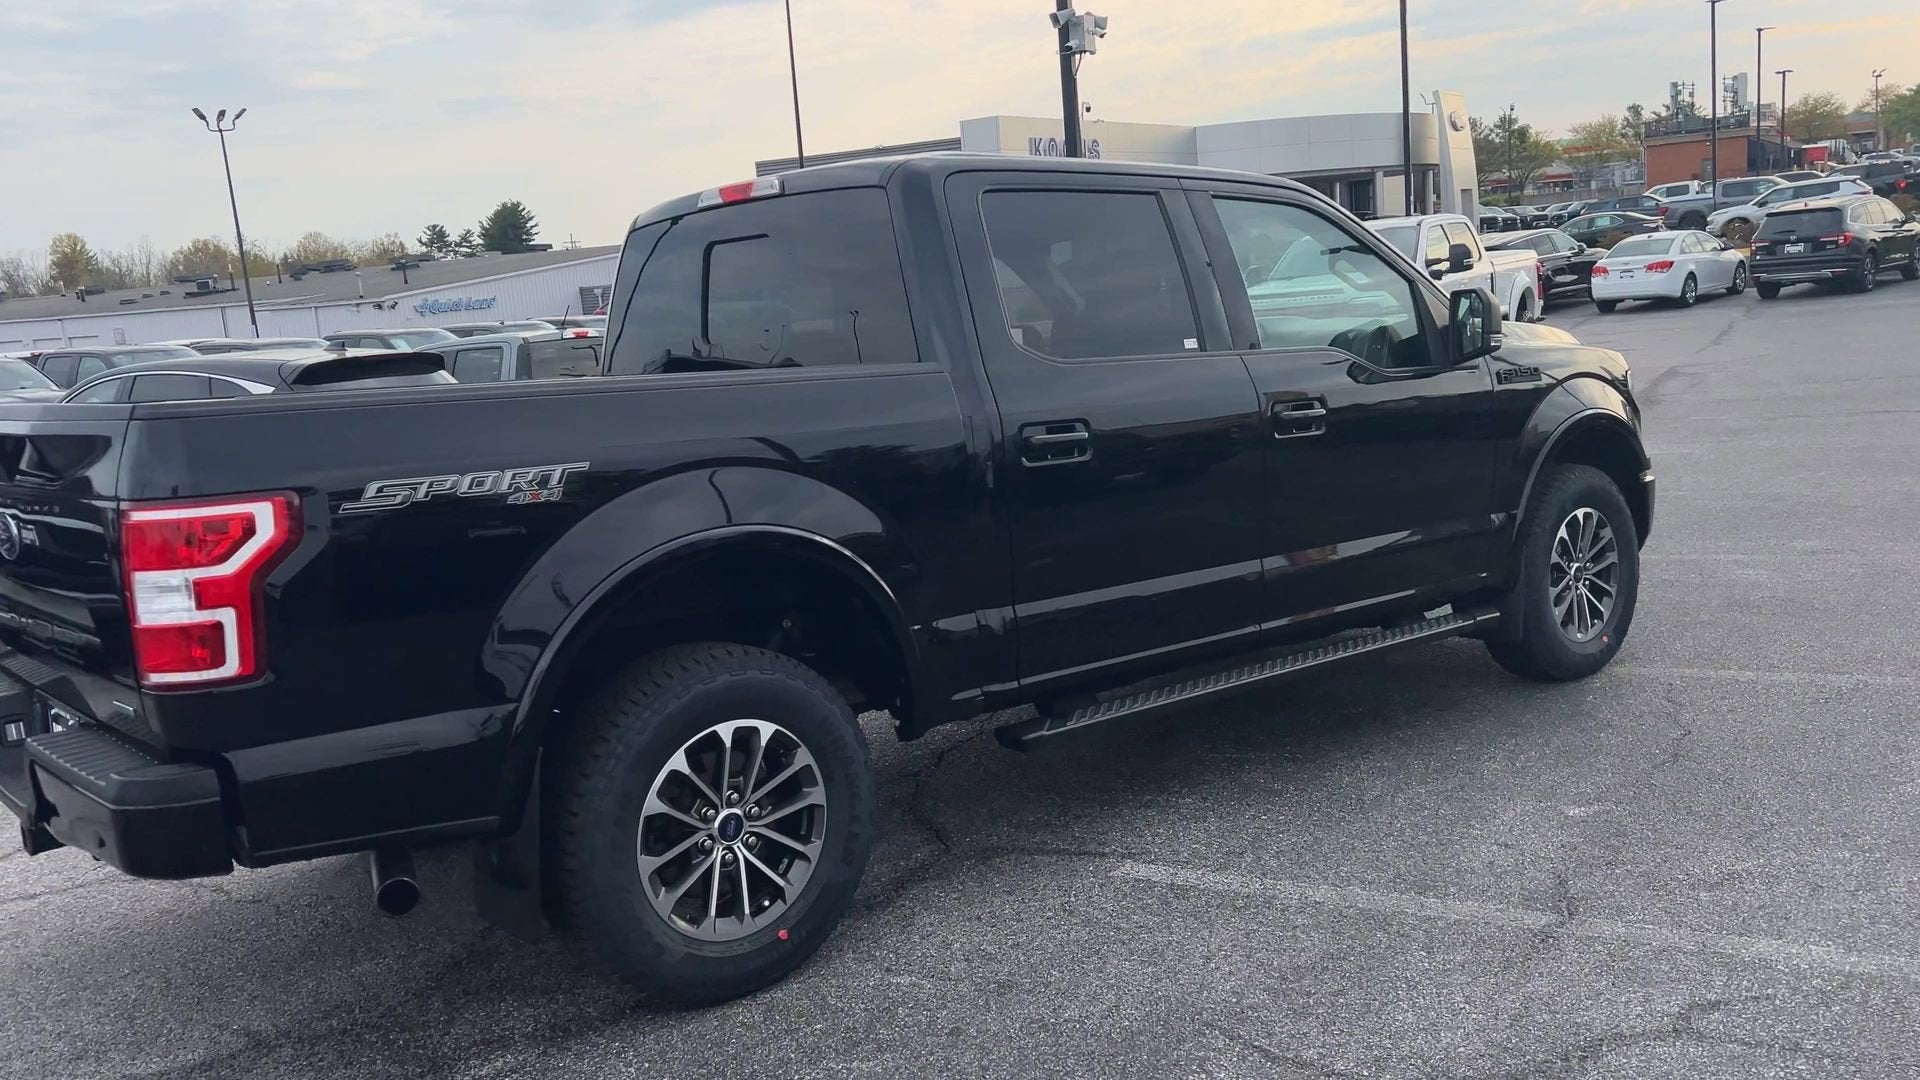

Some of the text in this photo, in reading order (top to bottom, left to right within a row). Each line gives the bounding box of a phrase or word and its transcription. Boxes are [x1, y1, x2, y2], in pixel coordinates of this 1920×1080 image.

[1030, 137, 1100, 159] KOS
[430, 295, 496, 315] Quick Lane
[338, 461, 590, 513] SPORT
